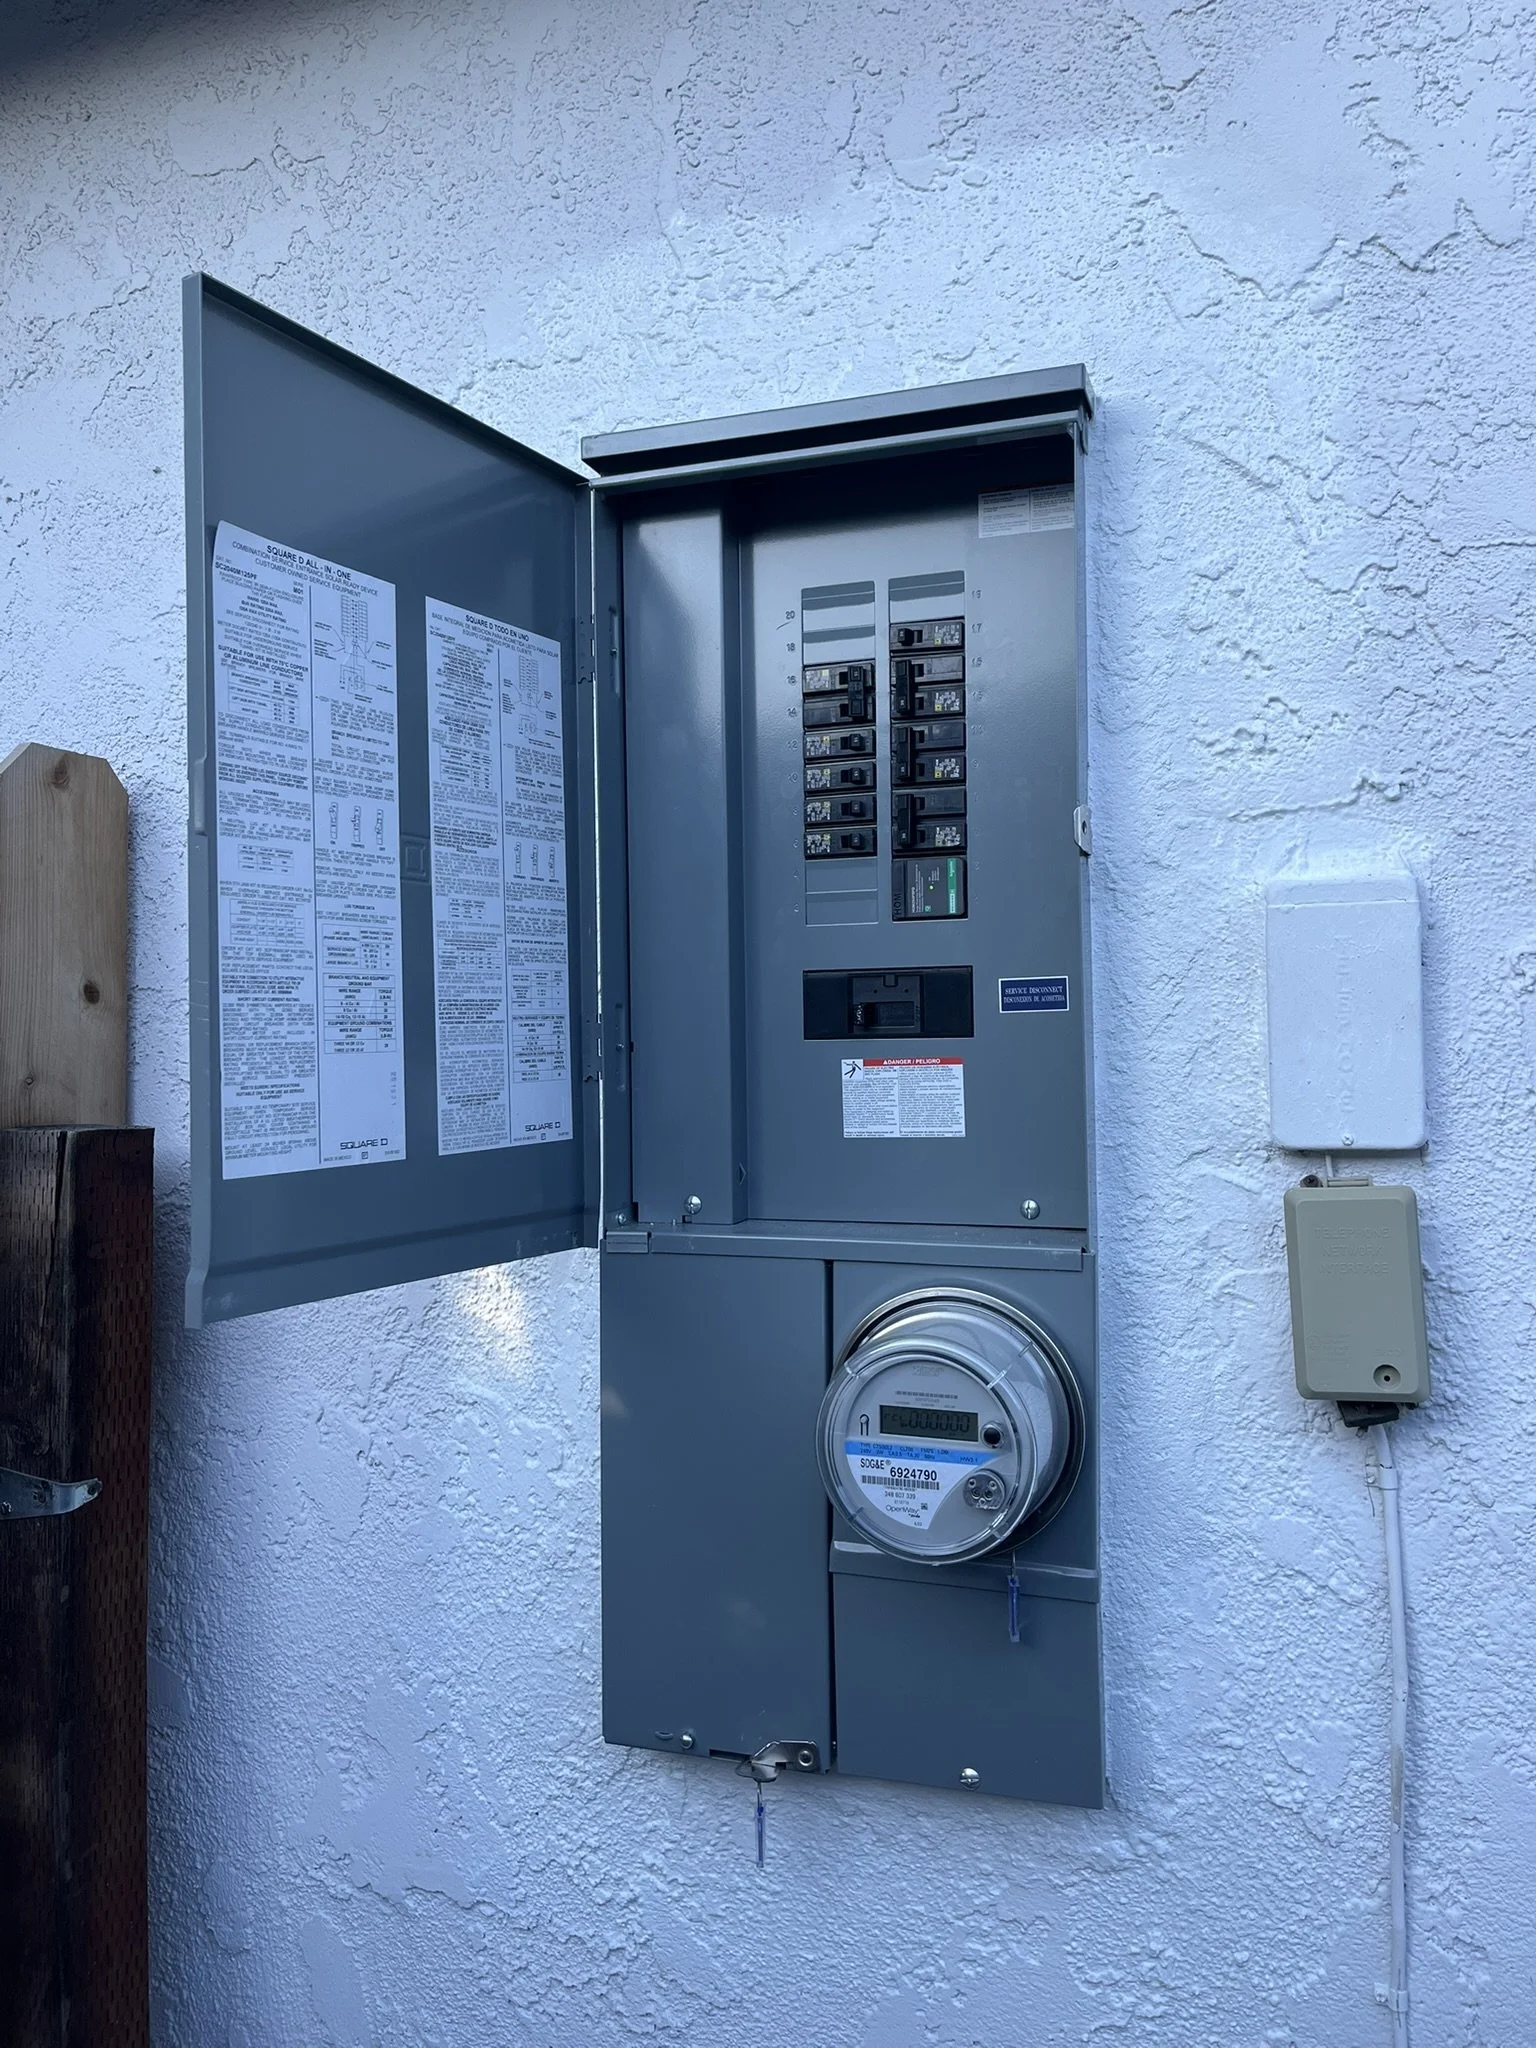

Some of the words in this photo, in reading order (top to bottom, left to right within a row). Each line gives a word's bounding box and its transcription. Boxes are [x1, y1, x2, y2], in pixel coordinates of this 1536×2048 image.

[232, 541, 270, 560] COMBINATION
[272, 555, 294, 566] SERVICE
[296, 564, 324, 578] ENTRANCE
[325, 574, 342, 584] SOLAR
[343, 580, 360, 590] READY
[360, 586, 378, 596] DEVICE
[267, 545, 296, 563] SQUARE
[298, 556, 304, 564] D
[306, 558, 319, 570] ALL
[324, 565, 332, 574] IN
[337, 570, 351, 580] ONE
[256, 558, 288, 575] CUSTOMER
[288, 570, 308, 581] OWNED
[309, 576, 332, 588] SERVICE
[332, 583, 362, 598] EQUIPMENT
[786, 610, 796, 620] 20
[466, 614, 488, 628] SQUARE
[494, 624, 509, 635] TODO
[510, 629, 517, 638] EN
[518, 634, 530, 642] UNO
[972, 622, 982, 632] 17
[444, 616, 464, 628] INTEGRAL
[547, 650, 559, 658] SOLAR
[786, 642, 796, 652] 18
[218, 644, 242, 656] SUITABLE
[290, 663, 309, 672] COPPER
[260, 661, 270, 669] LINE
[270, 664, 304, 678] CONDUCTORS
[1029, 986, 1063, 994] DISCONNECT
[524, 1122, 554, 1132] SQUARE
[340, 1138, 378, 1150] SQUARE
[380, 1138, 388, 1146] D
[1312, 1224, 1391, 1240] TELEPHONE
[1321, 1244, 1384, 1257] NETWORK
[1318, 1261, 1390, 1275] INTERFACE
[890, 1466, 938, 1481] 6924790
